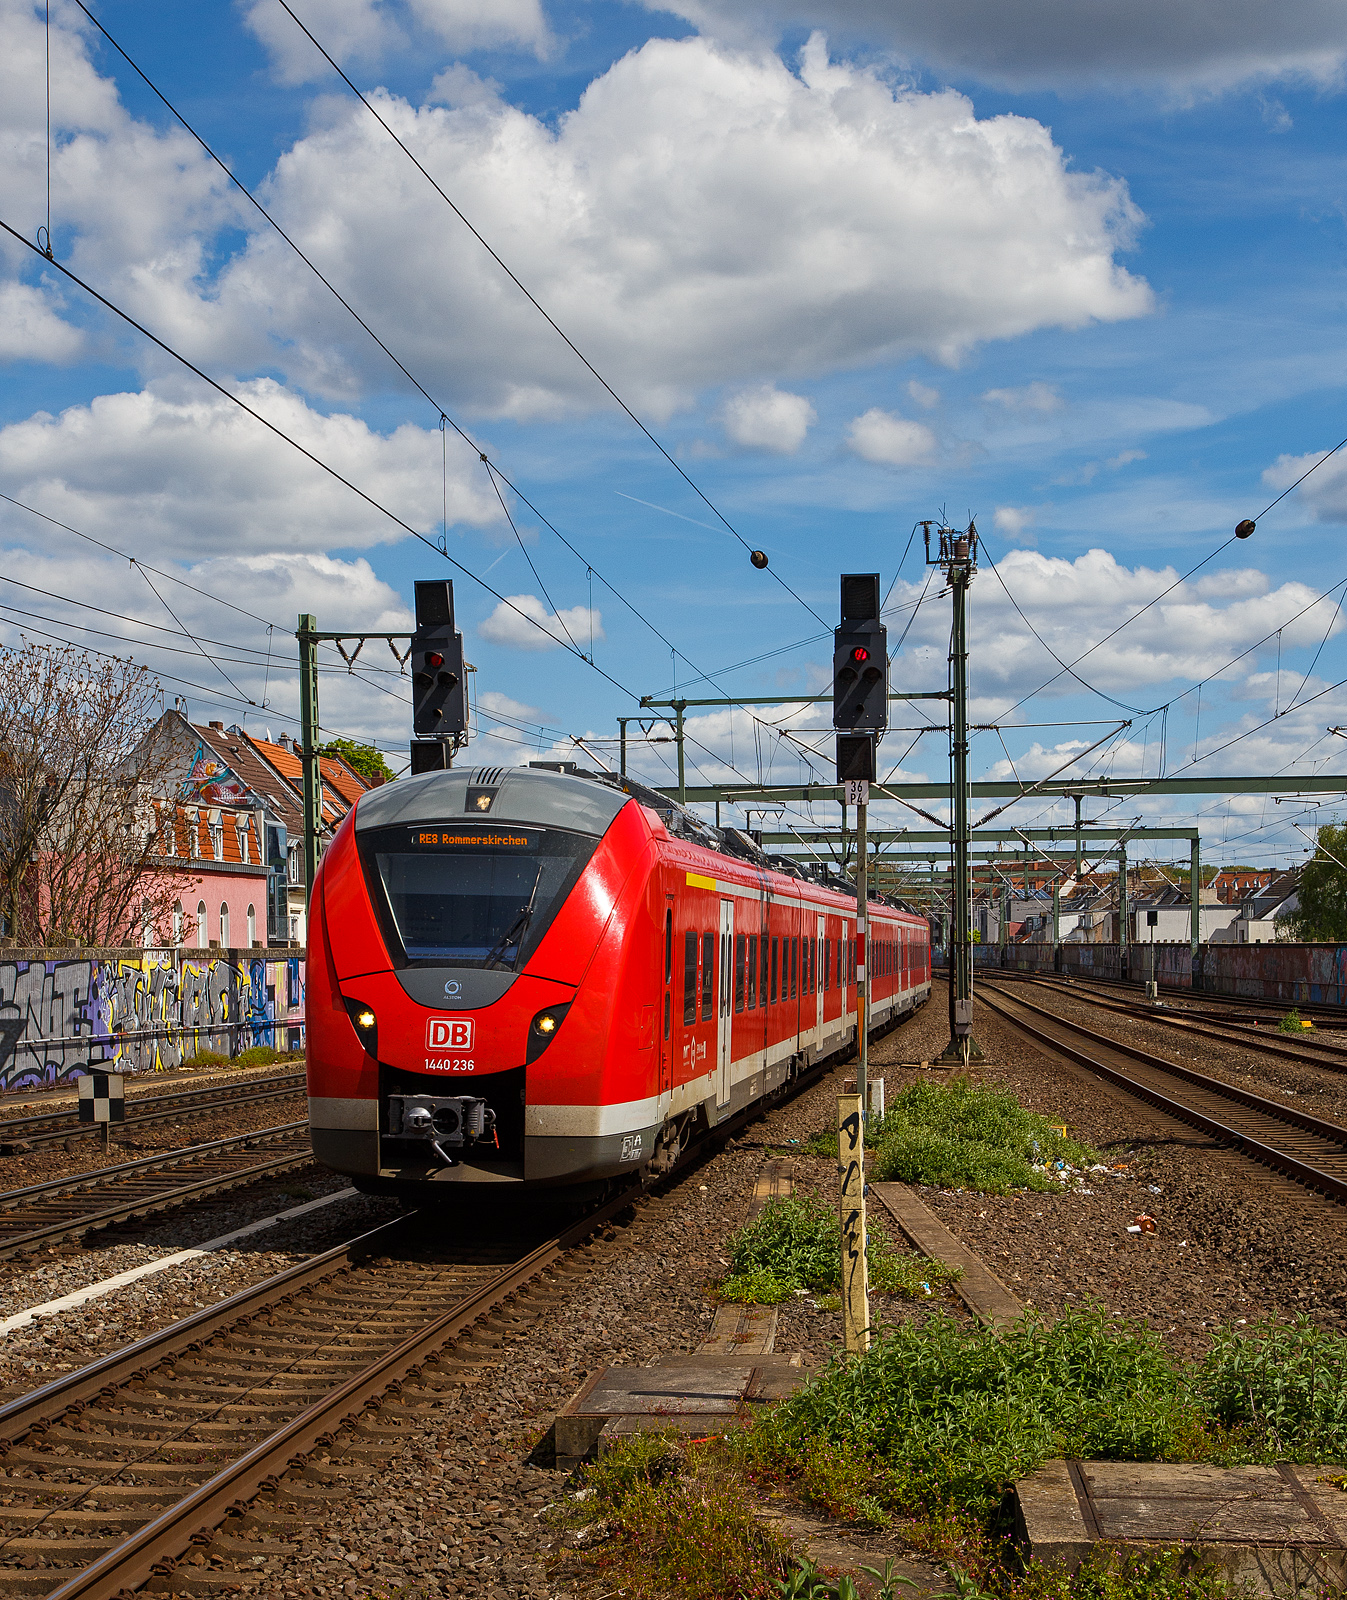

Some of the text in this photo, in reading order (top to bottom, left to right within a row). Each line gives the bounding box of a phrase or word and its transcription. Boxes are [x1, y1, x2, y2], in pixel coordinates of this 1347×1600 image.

[850, 780, 863, 793] 36
[850, 792, 863, 805] P4
[419, 833, 528, 846] RE8 Rommerskirchen
[430, 1021, 470, 1048] DB
[424, 1058, 475, 1071] 1440 236
